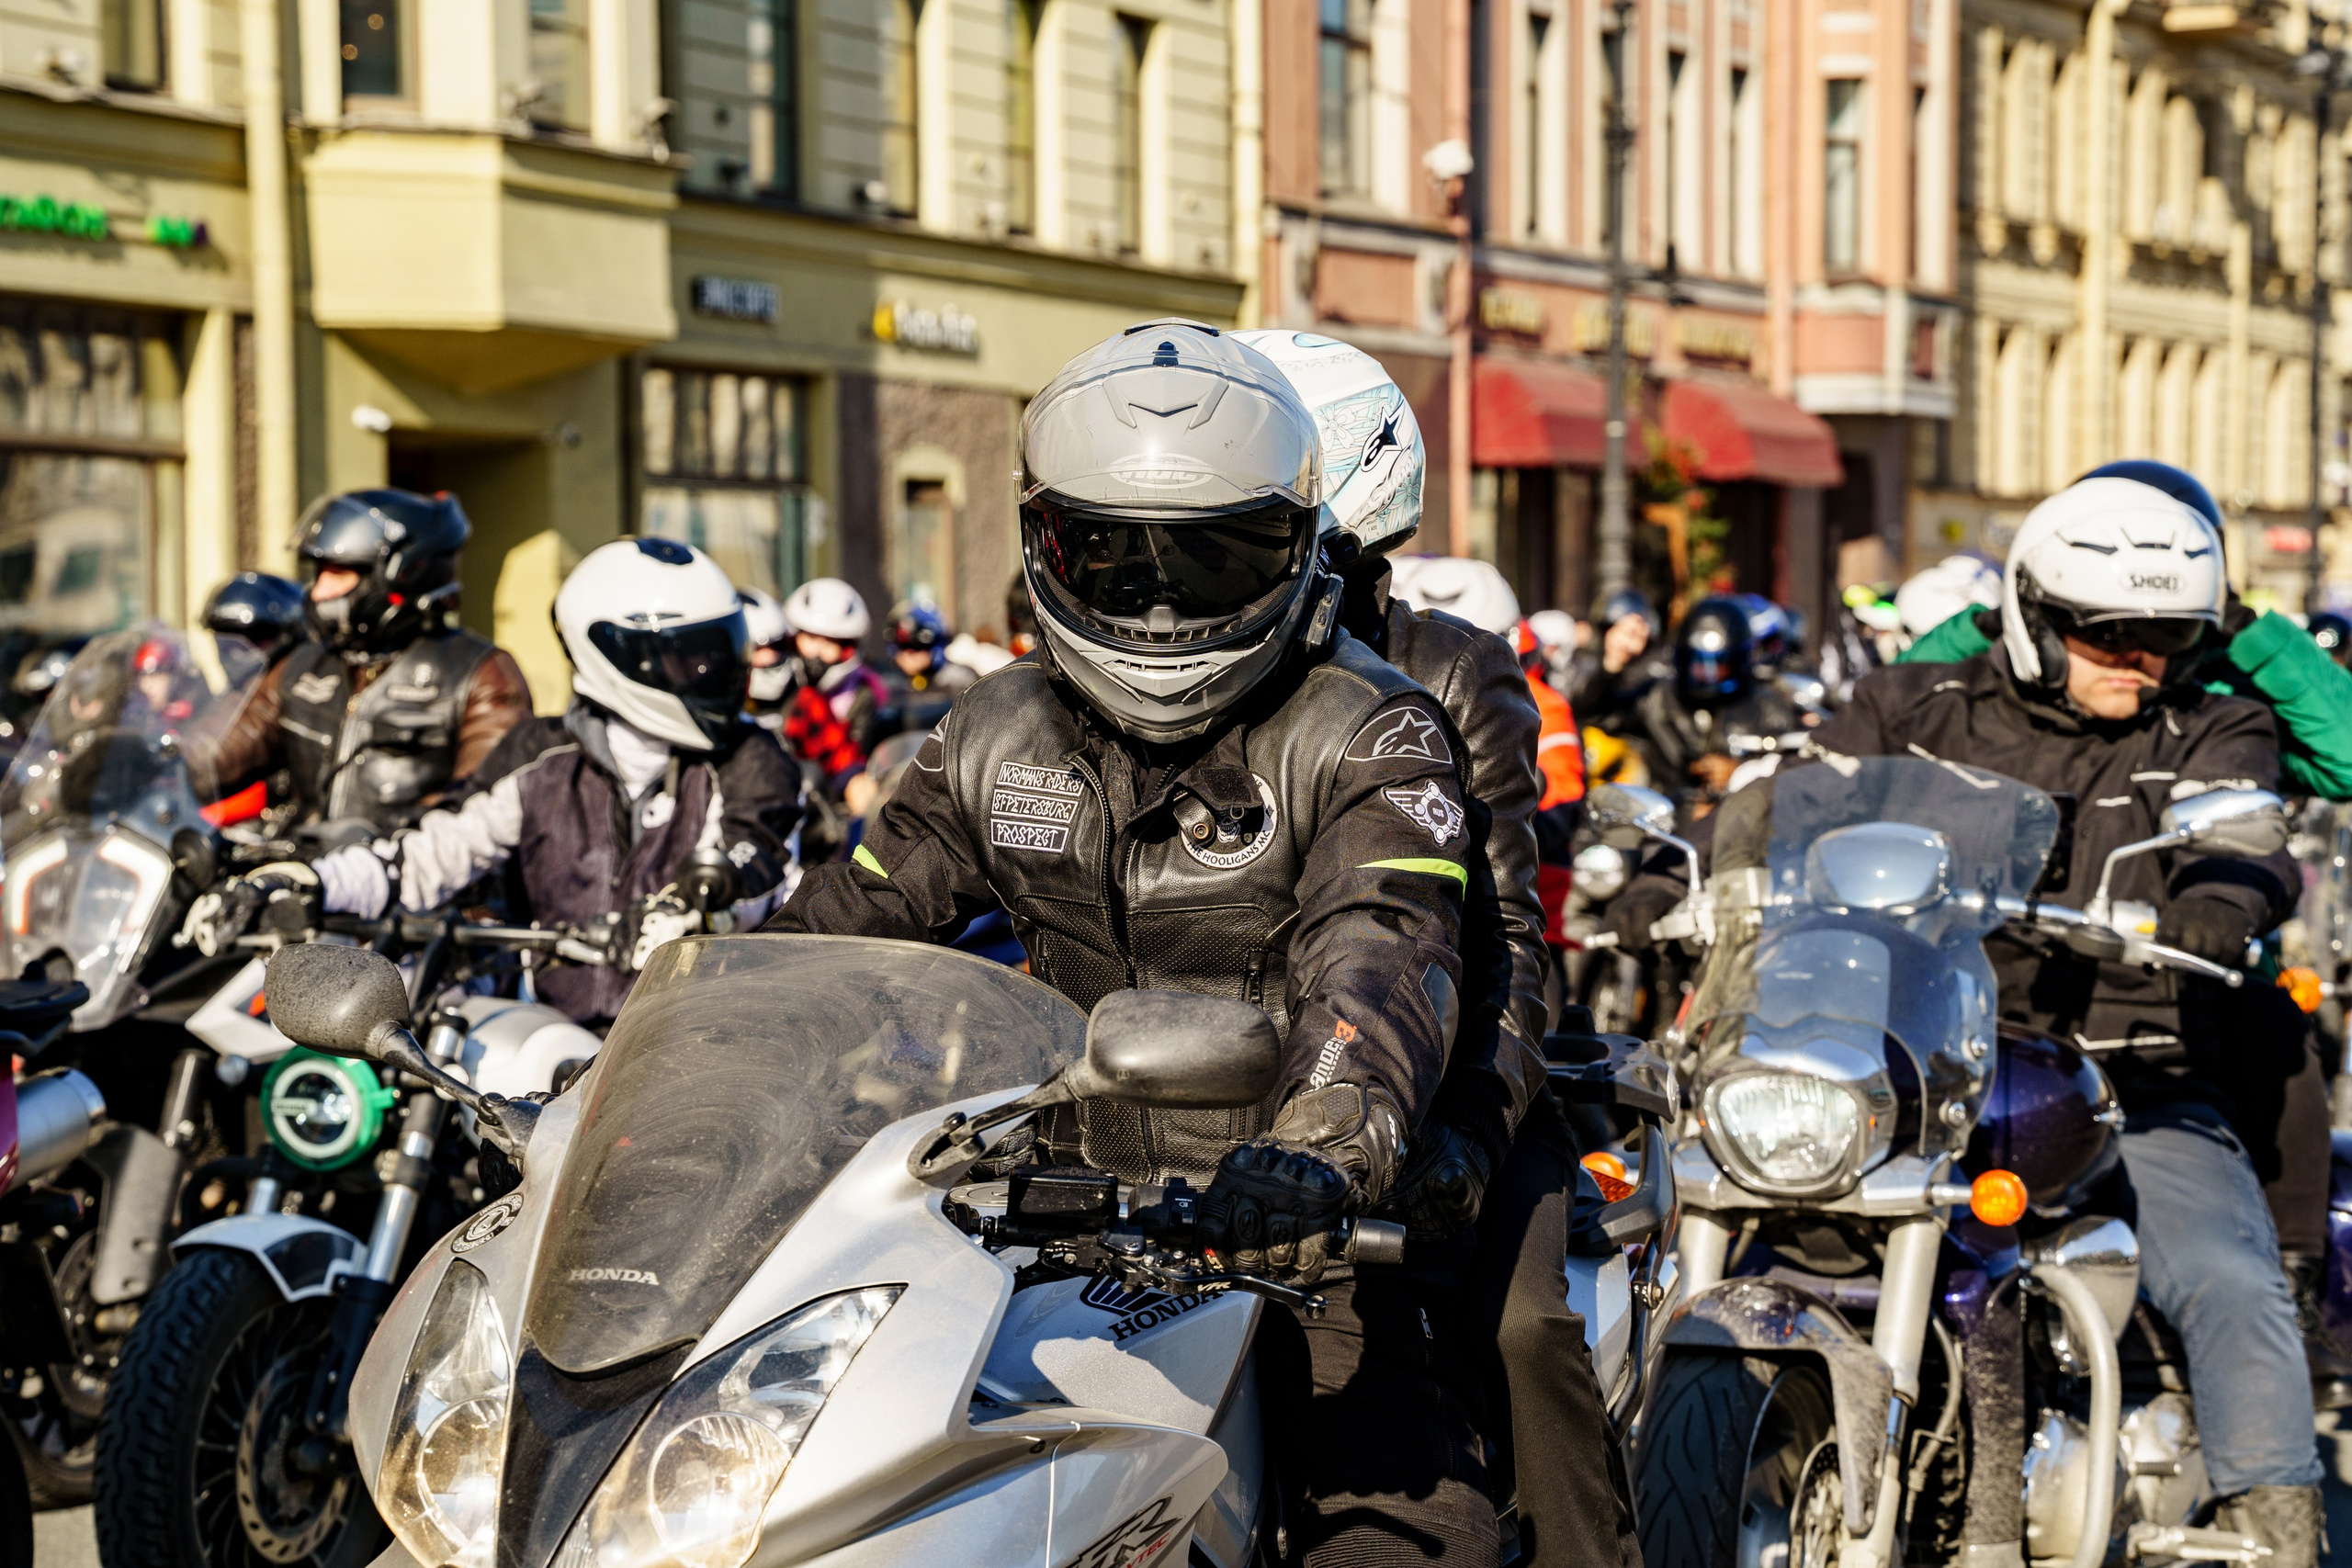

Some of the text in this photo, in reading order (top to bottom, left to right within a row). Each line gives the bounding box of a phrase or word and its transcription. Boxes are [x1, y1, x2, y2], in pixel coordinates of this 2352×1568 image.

[2130, 575, 2178, 590] SHOEI
[1000, 765, 1081, 793] NORMANS RIDERS
[996, 823, 1058, 849] PROSPECT
[1202, 844, 1260, 866] HOOLIGANS
[1258, 829, 1271, 848] MC
[570, 1268, 660, 1286] HONDA
[1197, 1281, 1231, 1292] VFR
[1107, 1291, 1224, 1342] HONDA
